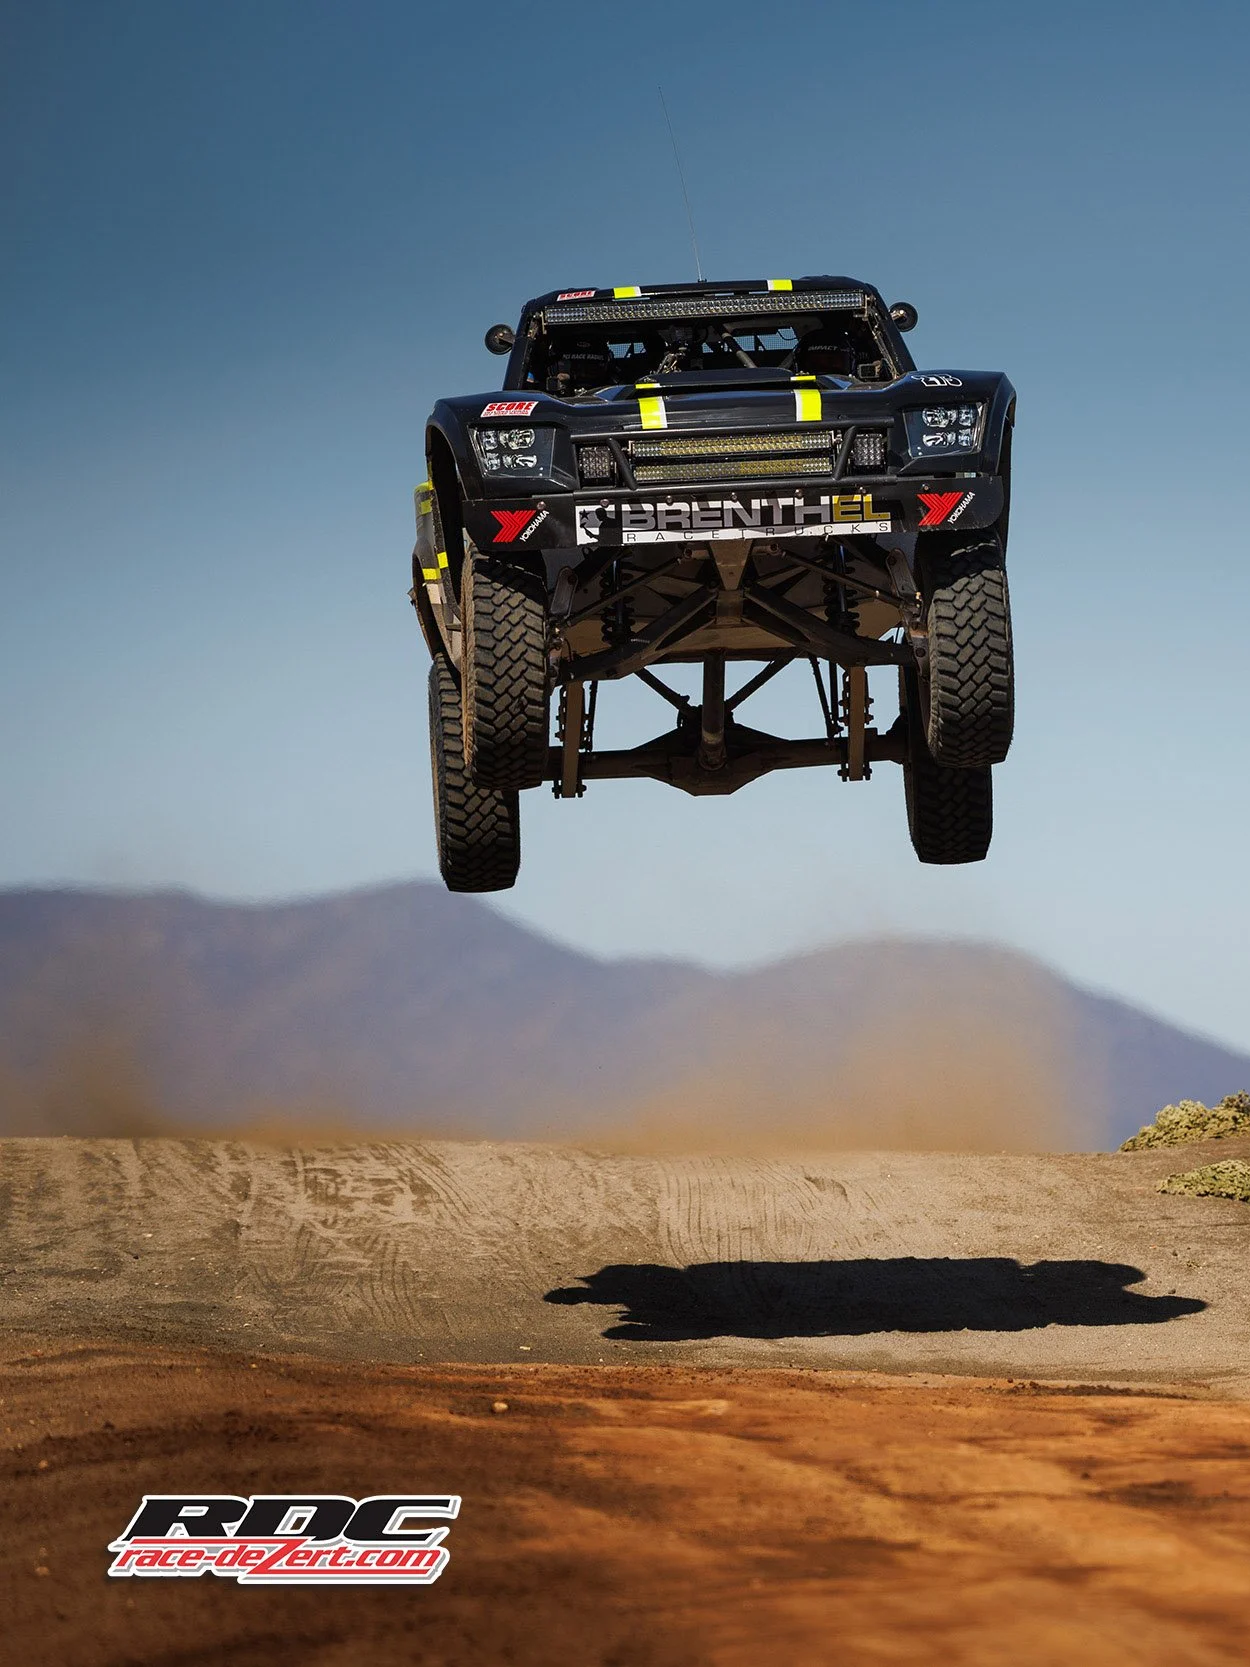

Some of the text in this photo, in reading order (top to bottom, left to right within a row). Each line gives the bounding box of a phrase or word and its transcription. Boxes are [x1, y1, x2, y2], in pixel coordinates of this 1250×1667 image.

[486, 402, 535, 412] SCORE
[621, 494, 891, 531] BRENTHEL
[947, 491, 976, 524] YOKOHAMA
[519, 510, 550, 542] YOKOHAMA
